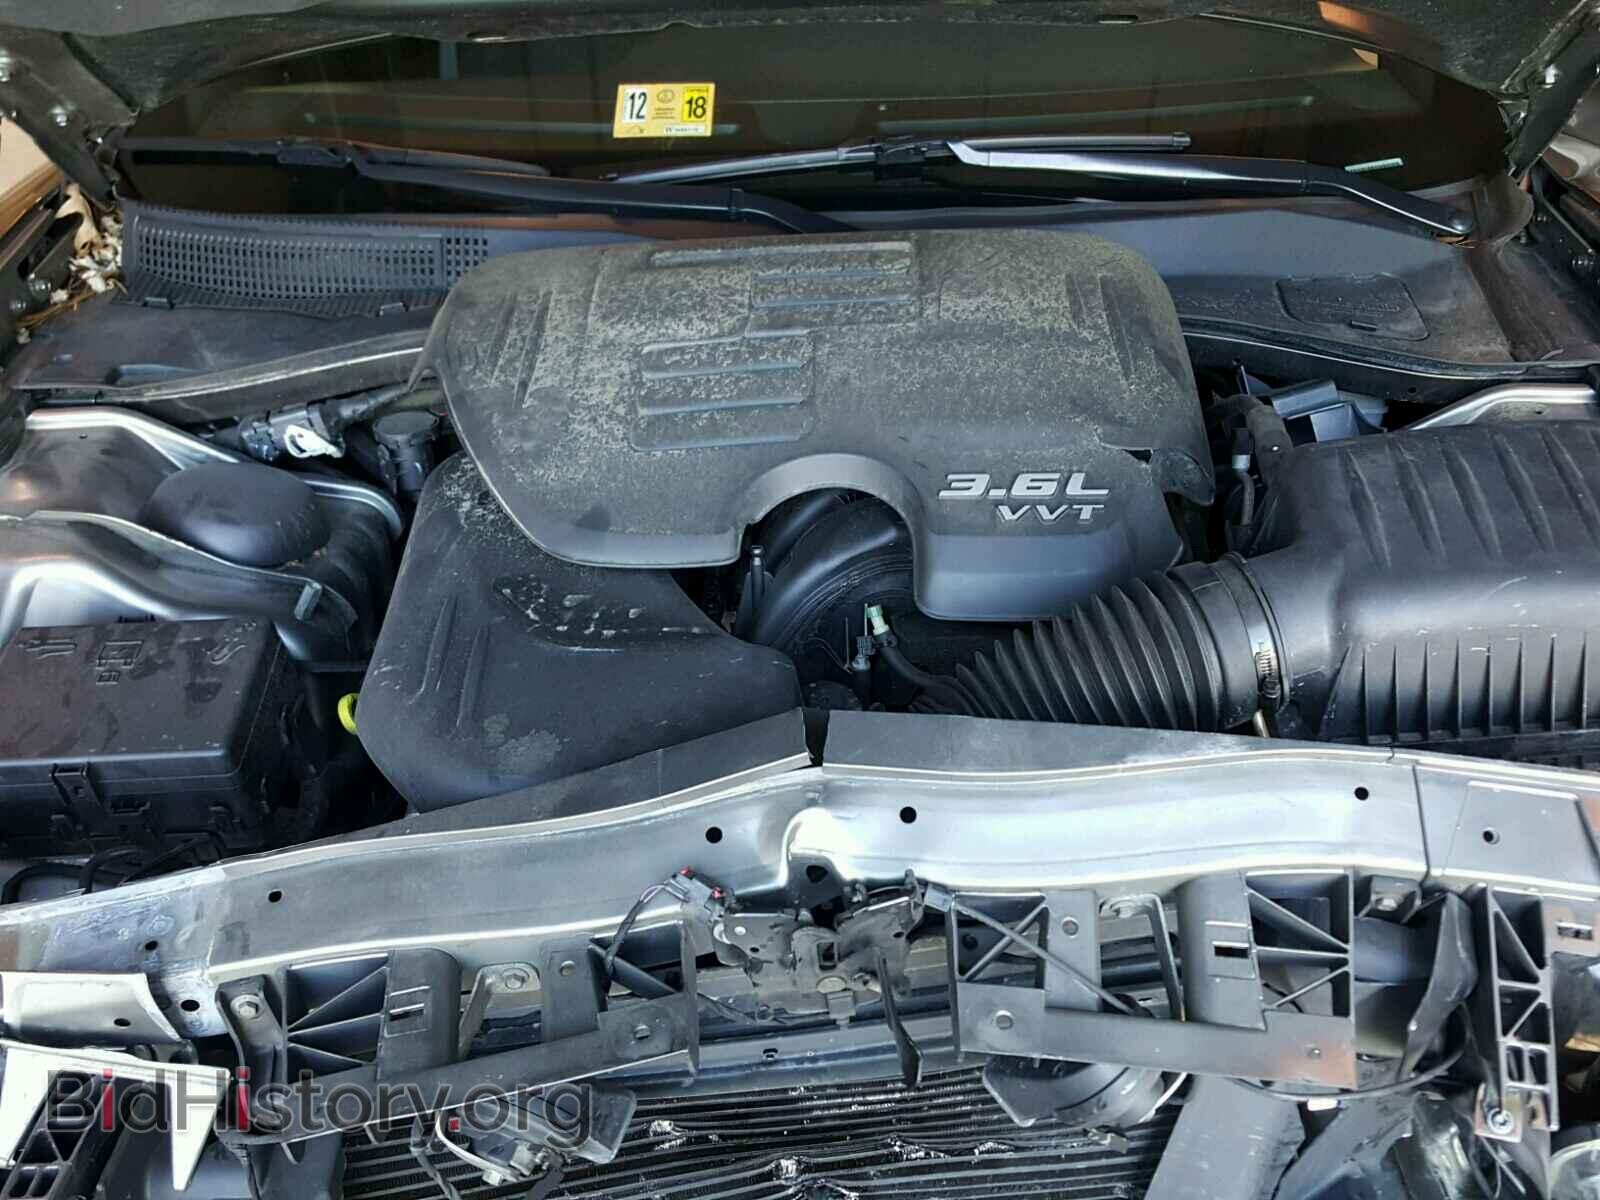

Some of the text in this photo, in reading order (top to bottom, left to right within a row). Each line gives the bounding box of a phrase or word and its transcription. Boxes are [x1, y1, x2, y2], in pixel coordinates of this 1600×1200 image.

[628, 91, 648, 119] 12
[685, 95, 706, 119] 18
[938, 472, 1110, 498] 3.6L
[997, 504, 1105, 522] VVT
